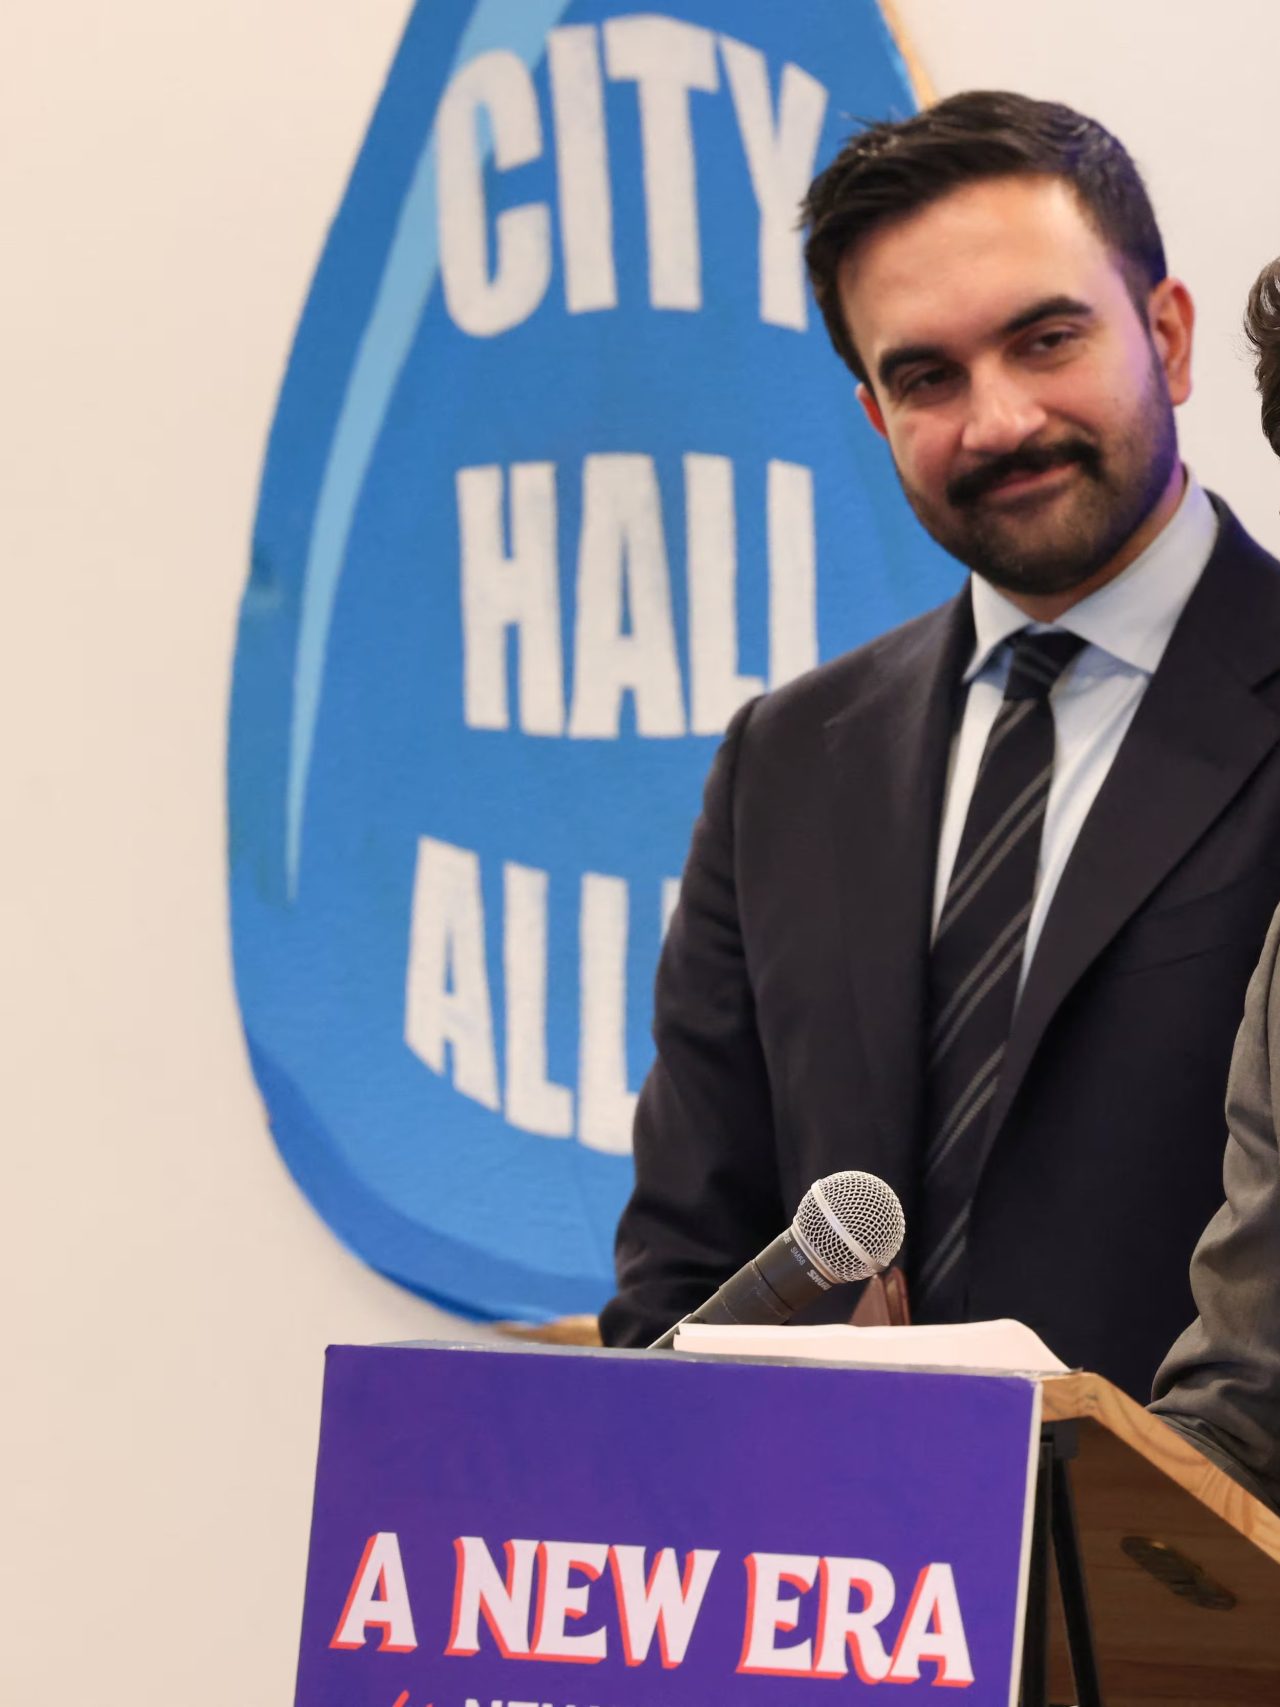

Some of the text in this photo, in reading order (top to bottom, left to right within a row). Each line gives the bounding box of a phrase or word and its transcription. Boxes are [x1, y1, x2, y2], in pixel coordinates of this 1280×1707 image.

[437, 13, 828, 338] CITY
[405, 834, 682, 1156] ALL
[790, 1246, 806, 1266] SM58
[329, 1532, 975, 1688] A NEW ERA
